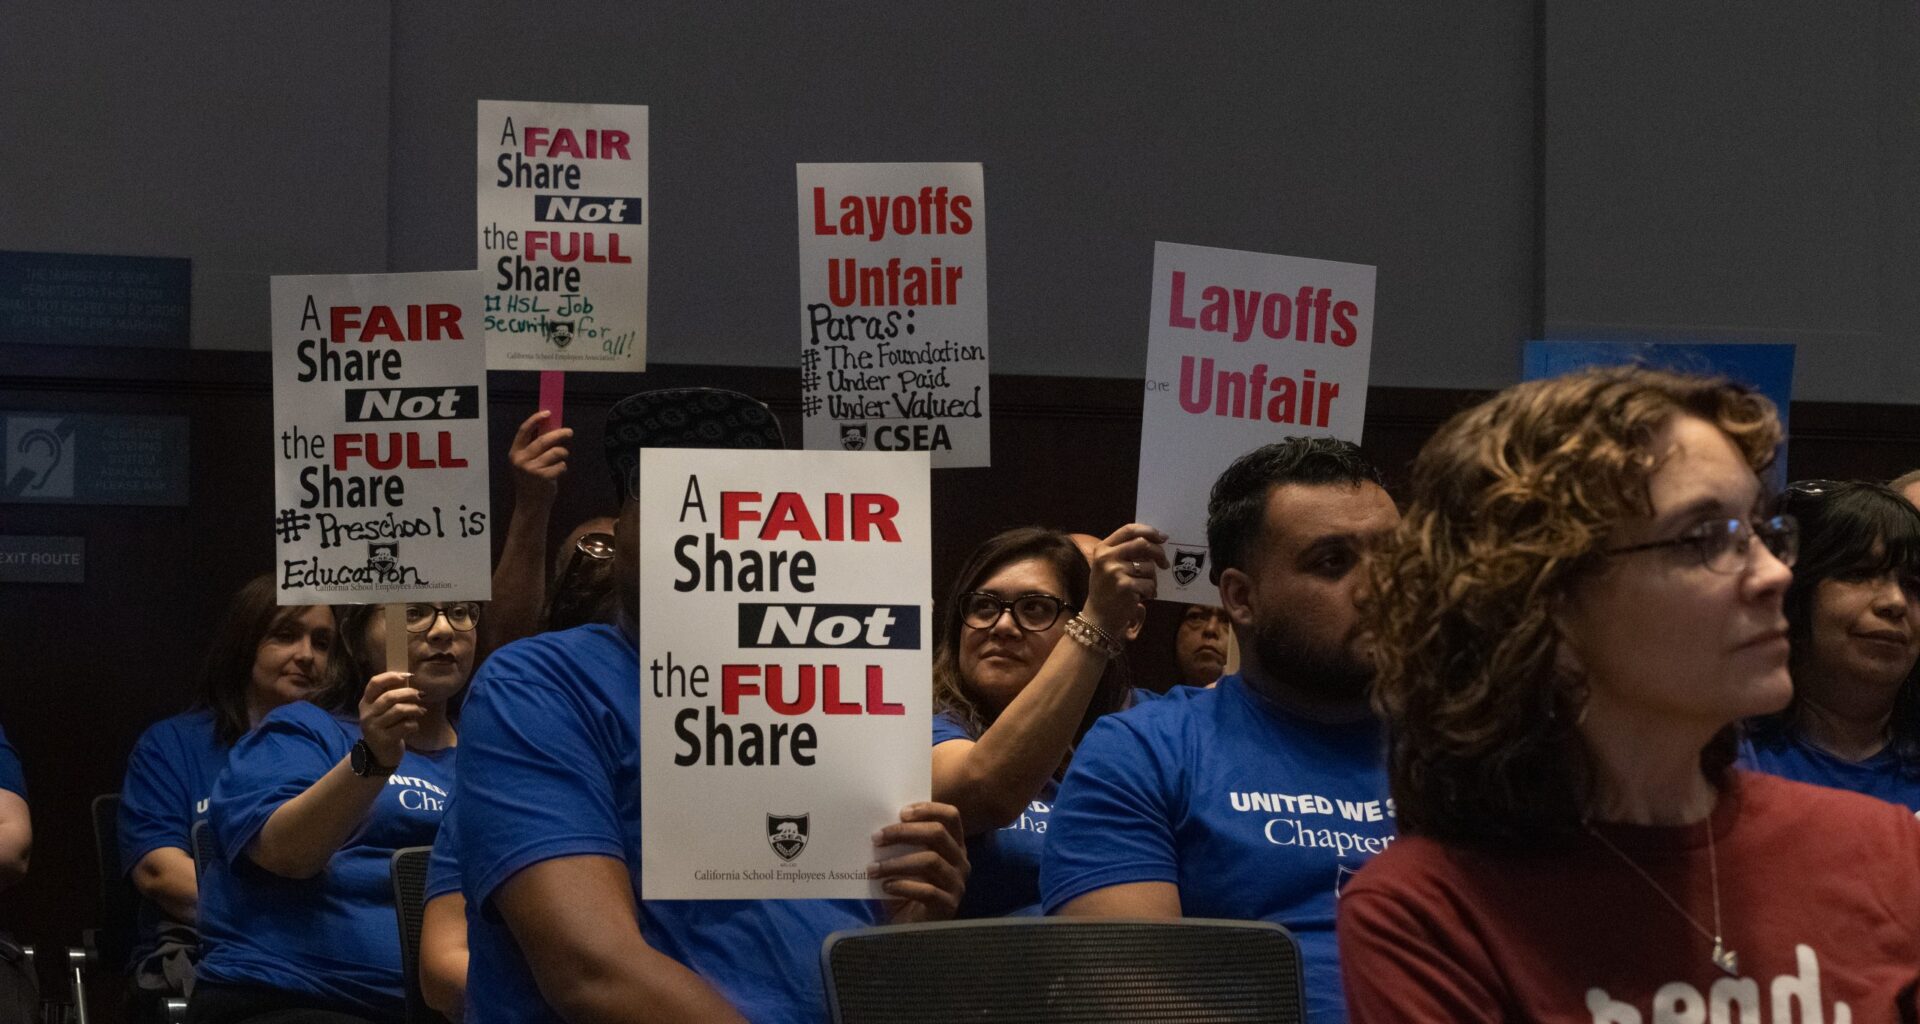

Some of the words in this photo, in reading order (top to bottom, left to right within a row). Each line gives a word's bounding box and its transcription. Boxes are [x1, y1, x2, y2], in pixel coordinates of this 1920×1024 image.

[500, 116, 516, 146] A
[524, 127, 631, 160] FAIR
[497, 152, 581, 190] Share
[545, 197, 627, 222] Not
[814, 186, 973, 242] Layoffs
[484, 222, 518, 250] the
[525, 231, 632, 264] FULL
[497, 255, 581, 293] Share
[828, 257, 962, 308] Unfair
[300, 294, 320, 331] A
[330, 304, 464, 343] FAIR
[557, 294, 593, 316] Job
[808, 303, 914, 345] Paras:
[1169, 270, 1359, 348] Layoffs
[578, 316, 610, 338] for
[297, 338, 402, 382] Share
[877, 340, 985, 368] Foundation
[358, 388, 460, 420] Not
[1178, 355, 1340, 428] Unfair
[282, 425, 325, 460] the
[334, 432, 468, 471] FULL
[874, 424, 952, 451] CSEA
[300, 464, 404, 509] Share
[460, 505, 486, 538] is
[679, 474, 707, 522] A
[720, 491, 902, 542] FAIR
[31, 552, 80, 565] ROUTE
[282, 556, 430, 590] Education
[674, 532, 816, 593] Share
[315, 584, 349, 592] California
[350, 582, 374, 591] School
[376, 582, 411, 592] Employees
[756, 606, 896, 646] Not
[650, 652, 709, 698] the
[722, 664, 906, 716] FULL
[674, 706, 818, 767] Share
[1230, 791, 1334, 815] UNITED
[1336, 798, 1384, 822] WE
[772, 833, 802, 841] CSEA
[1264, 818, 1395, 857] Chapter
[694, 870, 740, 880] California
[743, 870, 774, 880] School
[776, 870, 826, 882] Employees
